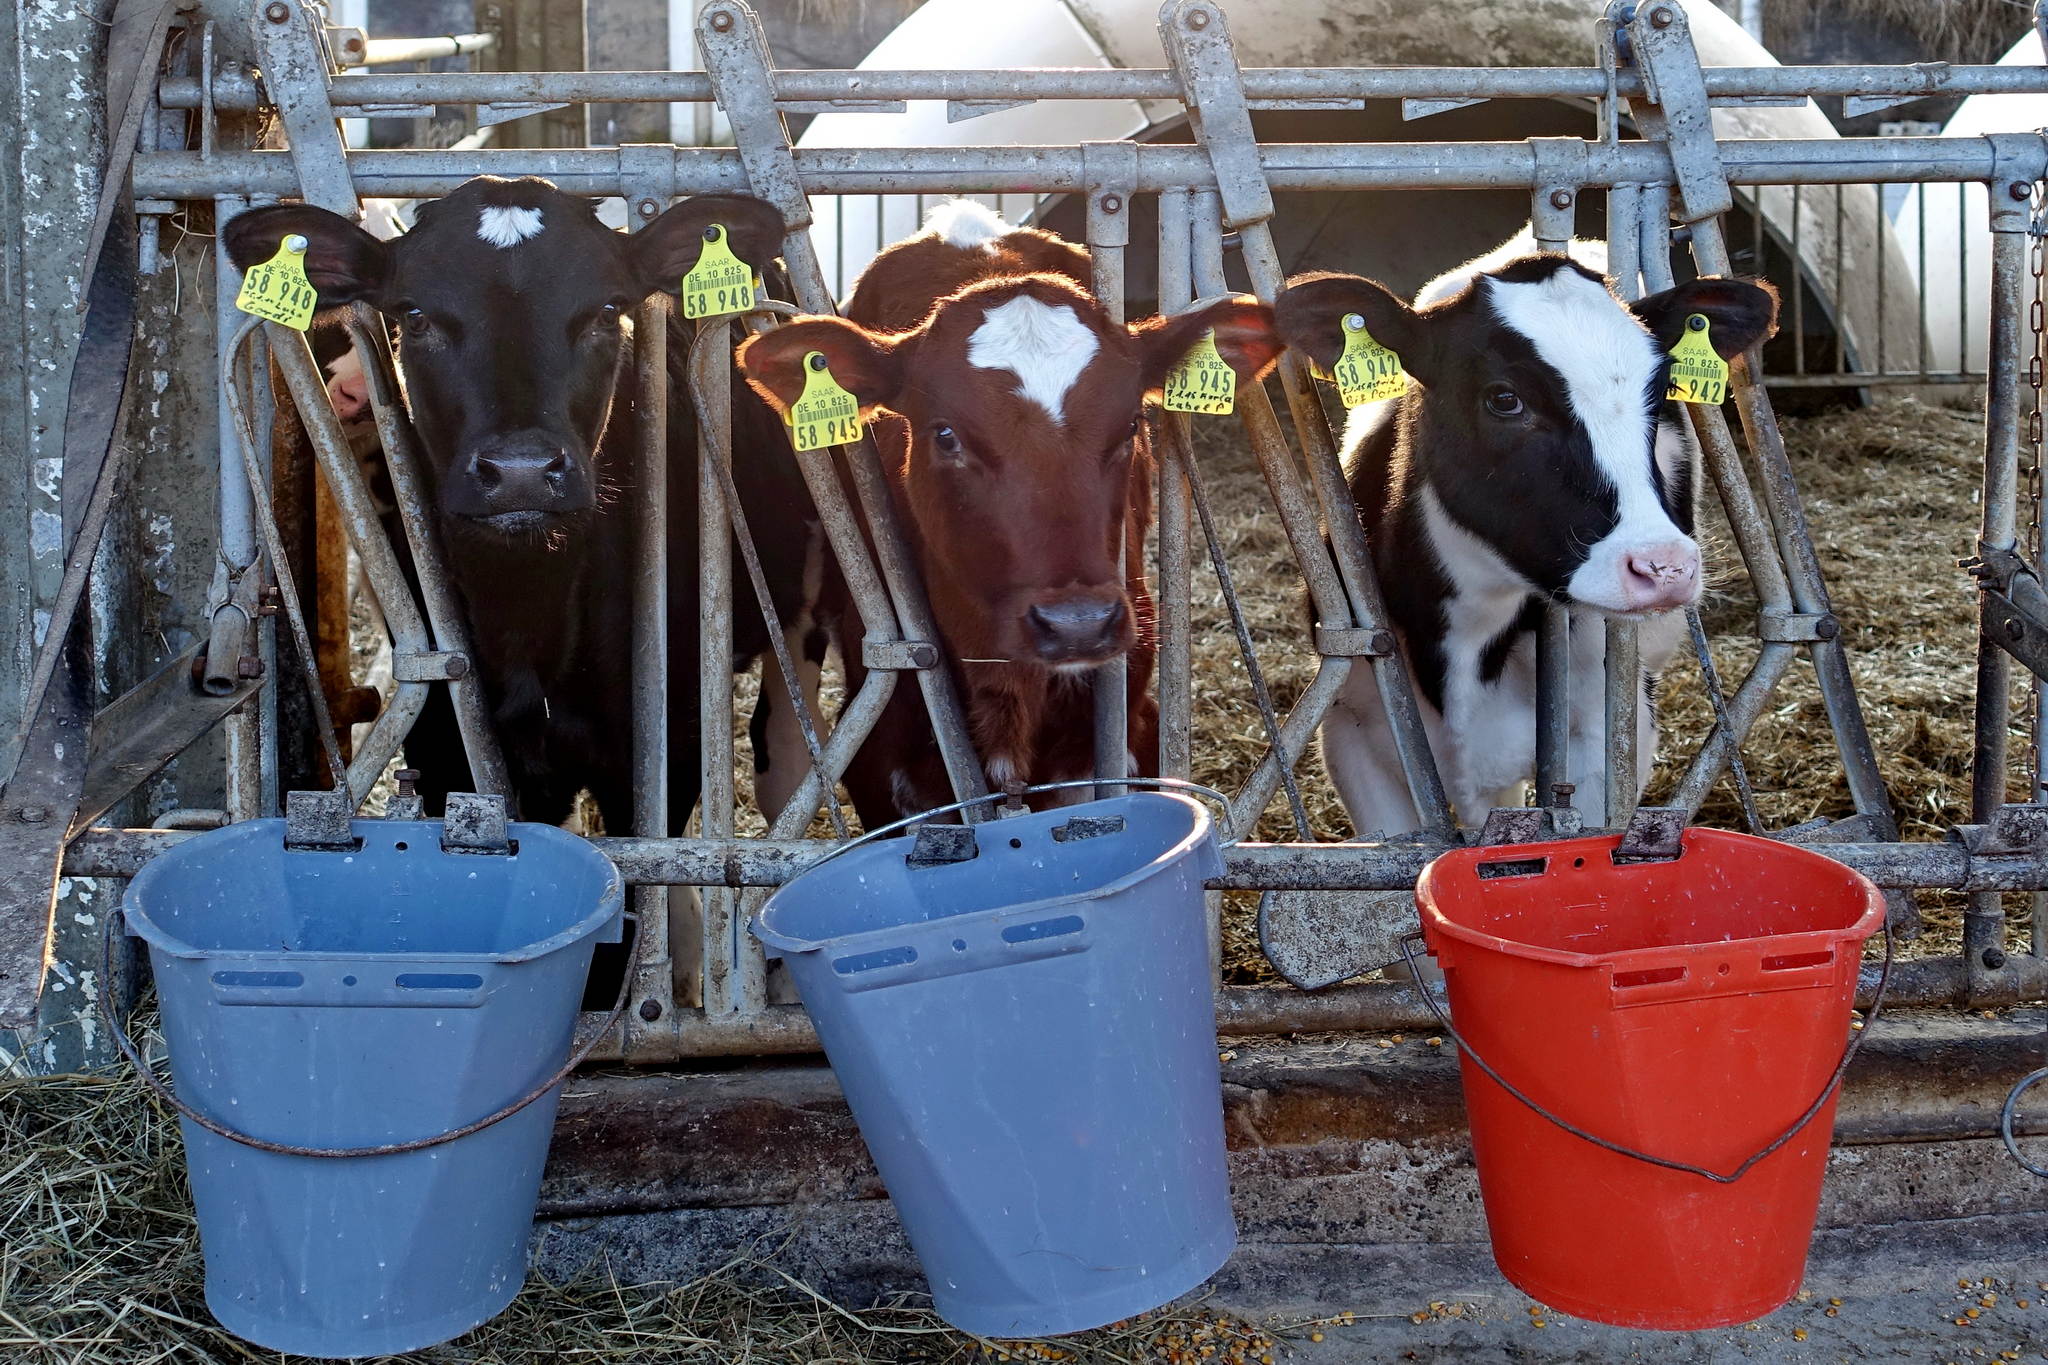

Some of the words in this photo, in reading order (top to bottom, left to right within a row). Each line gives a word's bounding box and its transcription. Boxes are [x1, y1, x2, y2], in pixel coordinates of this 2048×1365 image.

[275, 260, 300, 276] SAAR
[705, 258, 730, 268] SAAR
[264, 264, 276, 276] DE
[280, 270, 289, 280] 10
[292, 276, 307, 287] 825
[688, 273, 700, 282] DE
[707, 270, 718, 278] 10
[724, 265, 742, 276] 825
[247, 269, 270, 294] 58
[280, 282, 312, 310] 948
[688, 293, 706, 316] 58
[718, 286, 750, 312] 948
[1345, 354, 1356, 363] DE
[1359, 350, 1368, 360] 10
[1371, 348, 1384, 357] 825
[1350, 342, 1374, 352] SAAR
[1682, 347, 1708, 356] SAAR
[1195, 360, 1204, 368] 10
[1209, 362, 1224, 370] 825
[1338, 363, 1358, 387] 58
[1367, 354, 1398, 380] 942
[1683, 358, 1694, 366] 10
[1701, 359, 1718, 368] 825
[1200, 370, 1230, 393] 945
[1669, 376, 1678, 397] 8
[1690, 379, 1720, 402] 942
[812, 387, 835, 398] SAAR
[798, 402, 809, 412] DE
[815, 400, 826, 409] 10
[832, 395, 848, 406] 825
[798, 424, 818, 448] 58
[828, 416, 858, 444] 945
